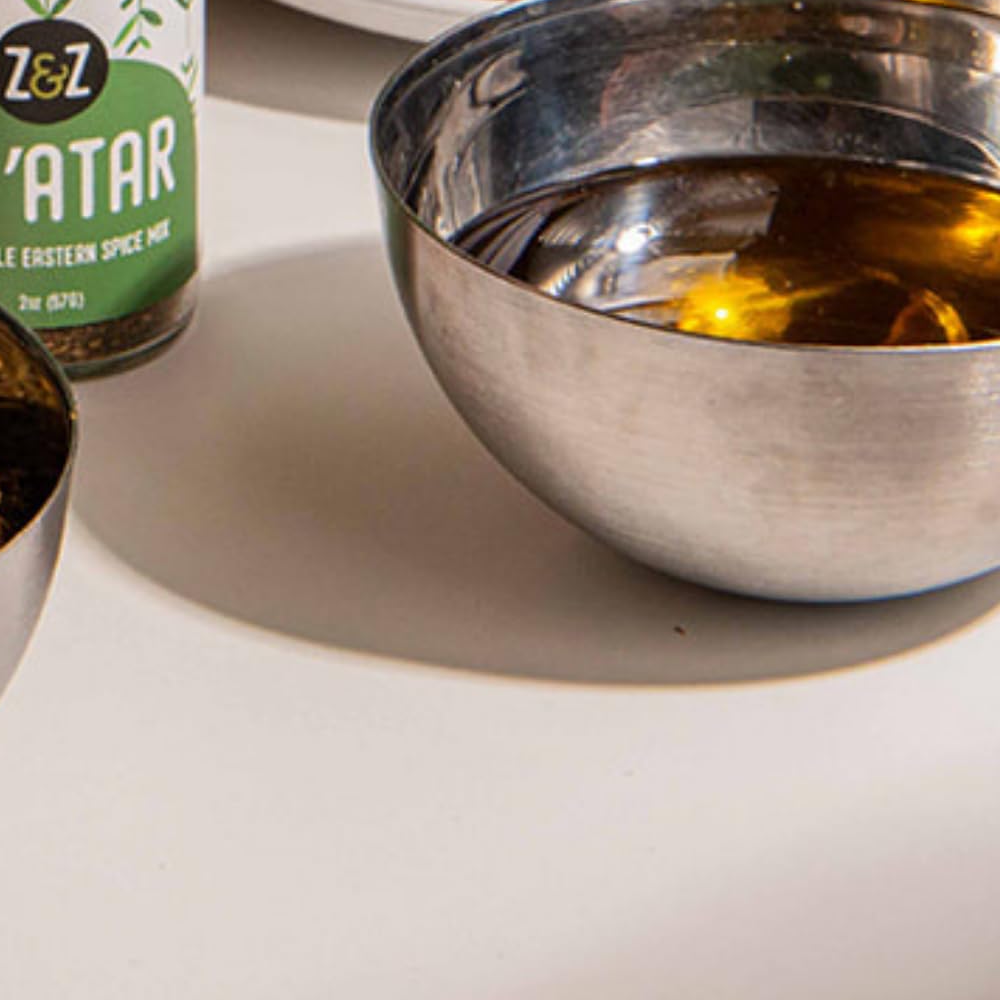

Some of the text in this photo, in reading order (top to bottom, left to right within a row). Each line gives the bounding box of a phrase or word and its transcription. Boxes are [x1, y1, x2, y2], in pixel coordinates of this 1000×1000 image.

[4, 42, 92, 100] Z&Z
[21, 244, 98, 269] EASTERN
[101, 228, 143, 261] SPICE
[146, 217, 170, 249] MIX
